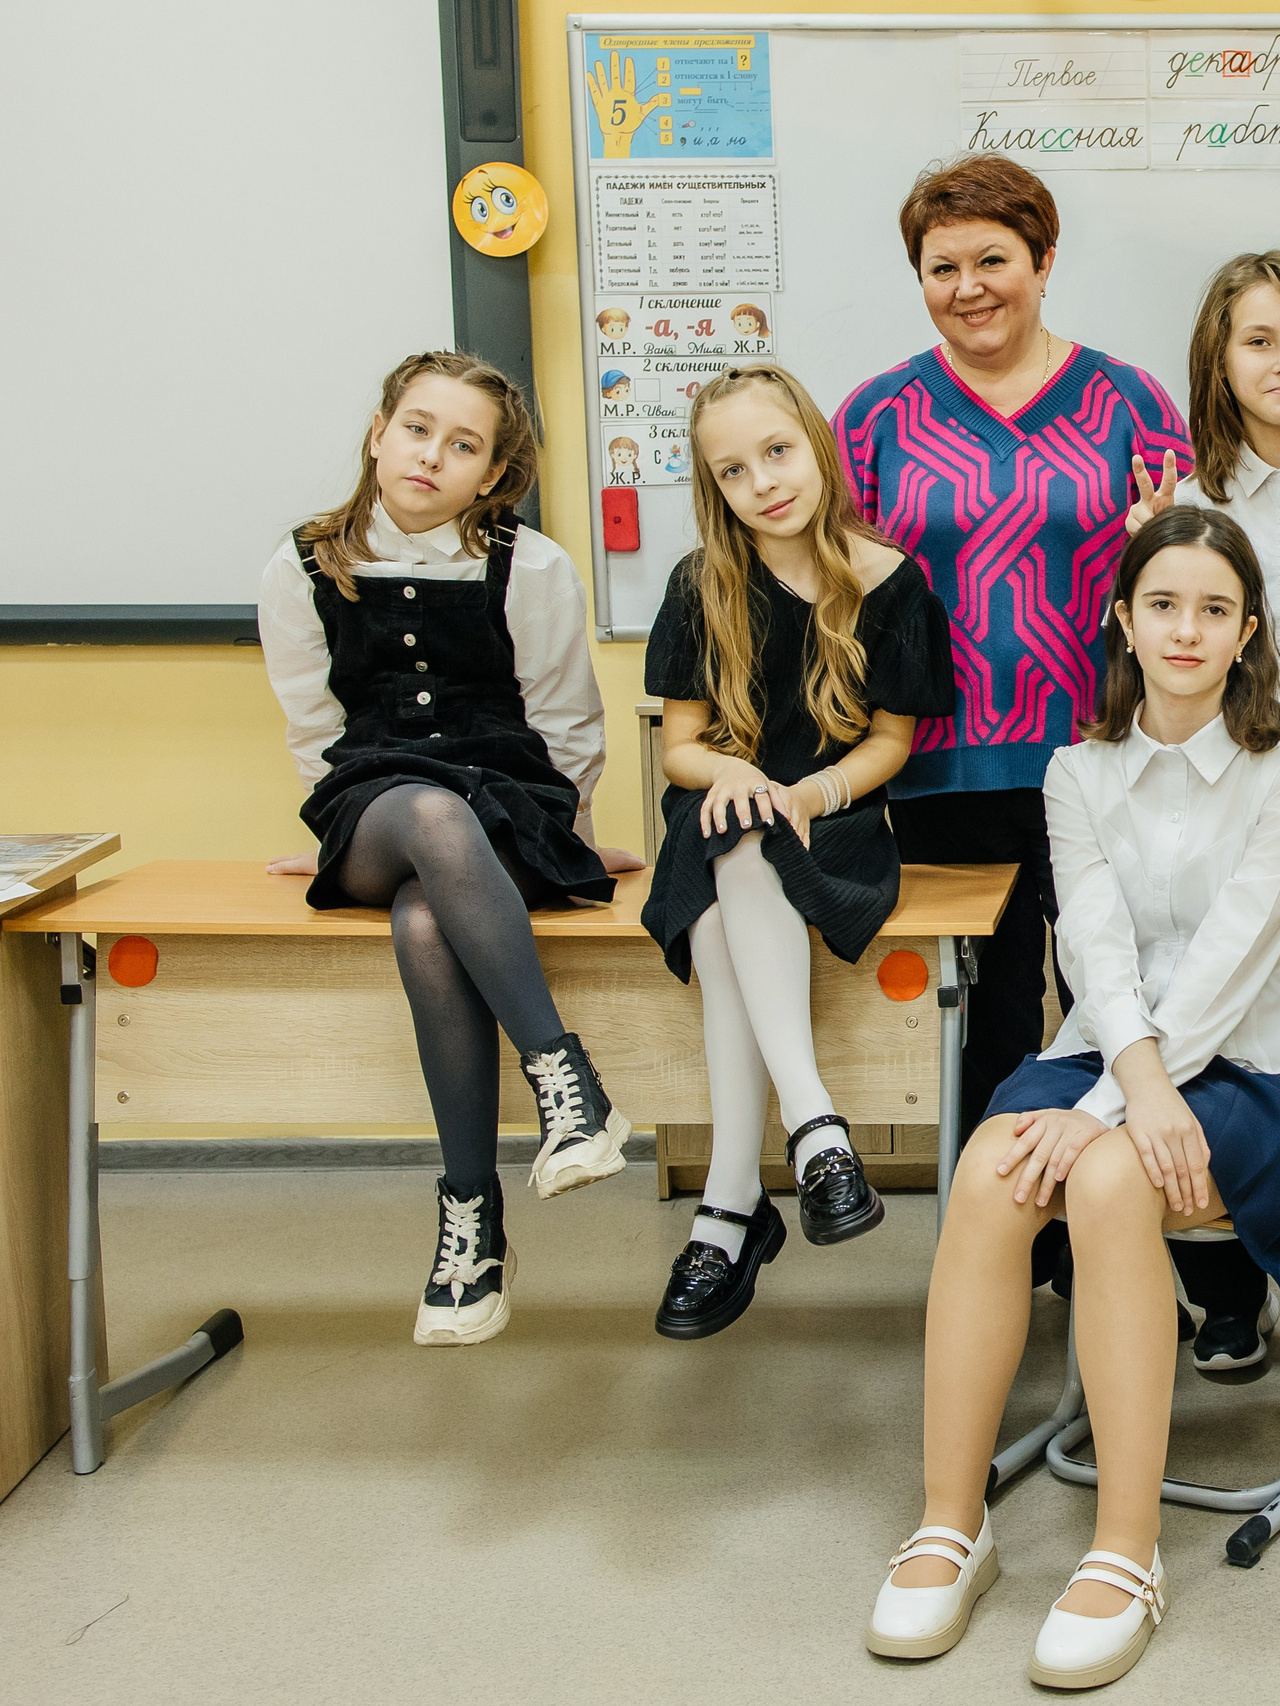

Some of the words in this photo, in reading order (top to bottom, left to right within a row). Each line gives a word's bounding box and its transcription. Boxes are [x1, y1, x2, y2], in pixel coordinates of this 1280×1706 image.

[603, 38, 659, 47] Однородные
[693, 38, 752, 47] предложения
[740, 55, 748, 66] ?
[733, 73, 758, 82] слову
[1007, 58, 1097, 98] Первое
[677, 97, 702, 105] могут
[707, 95, 727, 104] быть
[610, 99, 627, 126] 5
[968, 109, 1143, 150] Классная
[606, 182, 645, 190] ПАДЕЖИ
[676, 181, 766, 190] СУЩЕСТВИТЕЛЬНЫХ
[619, 197, 643, 206] ПАДЕЖИ
[639, 296, 645, 309] 1
[648, 298, 722, 309] склонение
[687, 318, 716, 337] -я
[600, 342, 636, 355] М.Р.
[643, 342, 676, 355] Ваня
[687, 341, 725, 354] Мила
[733, 340, 771, 353] Ж.Р.
[642, 358, 651, 372] 2
[603, 404, 640, 417] М.Р.
[642, 404, 676, 417] Иван
[648, 424, 658, 439] 3
[609, 471, 646, 485] Ж.Р.
